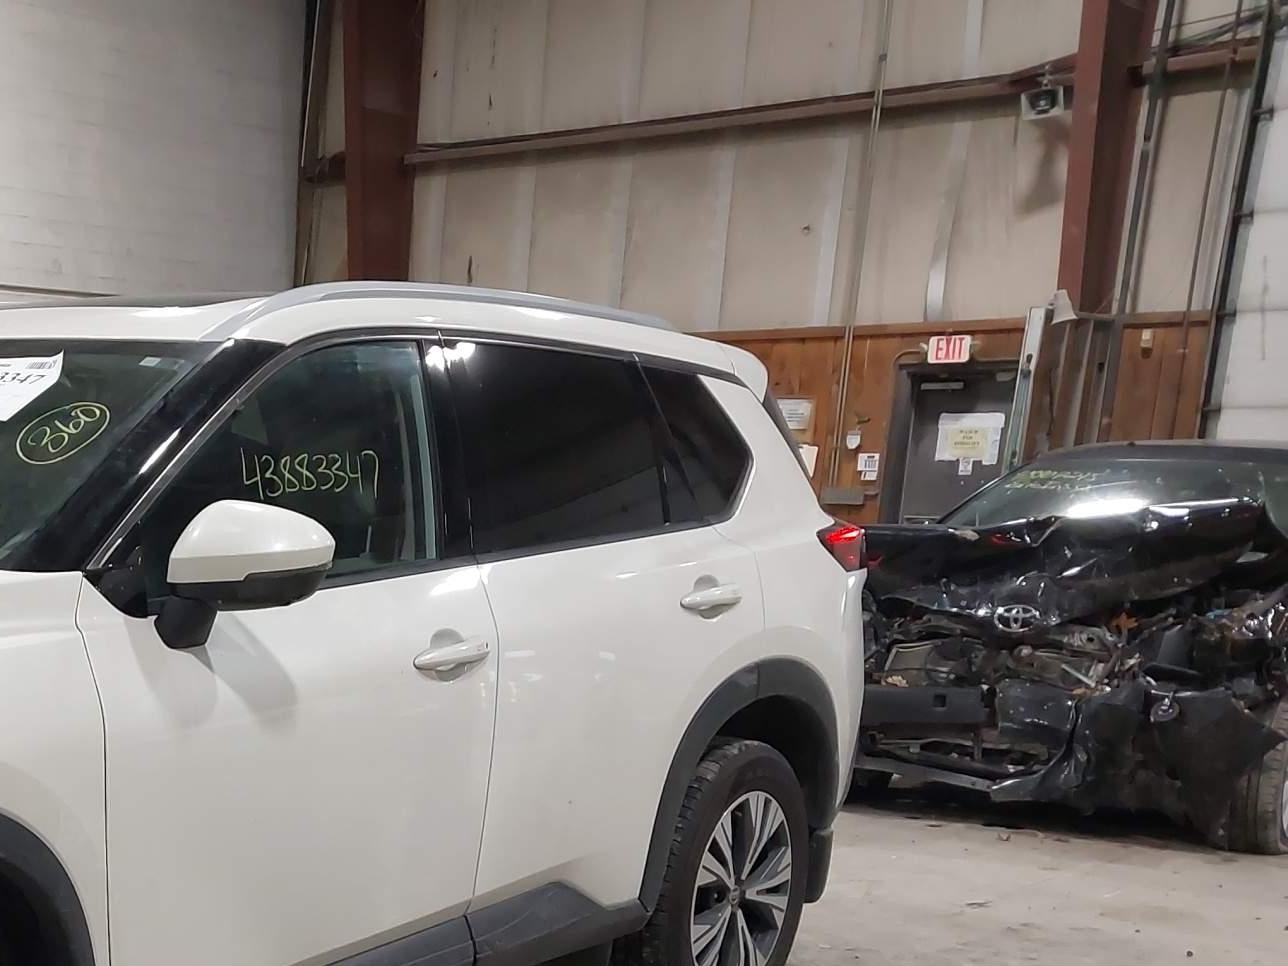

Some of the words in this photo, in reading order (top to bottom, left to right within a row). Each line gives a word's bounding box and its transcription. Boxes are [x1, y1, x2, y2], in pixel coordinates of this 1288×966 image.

[935, 335, 966, 361] EXIT
[26, 405, 102, 454] 360
[239, 446, 381, 501] 43883347
